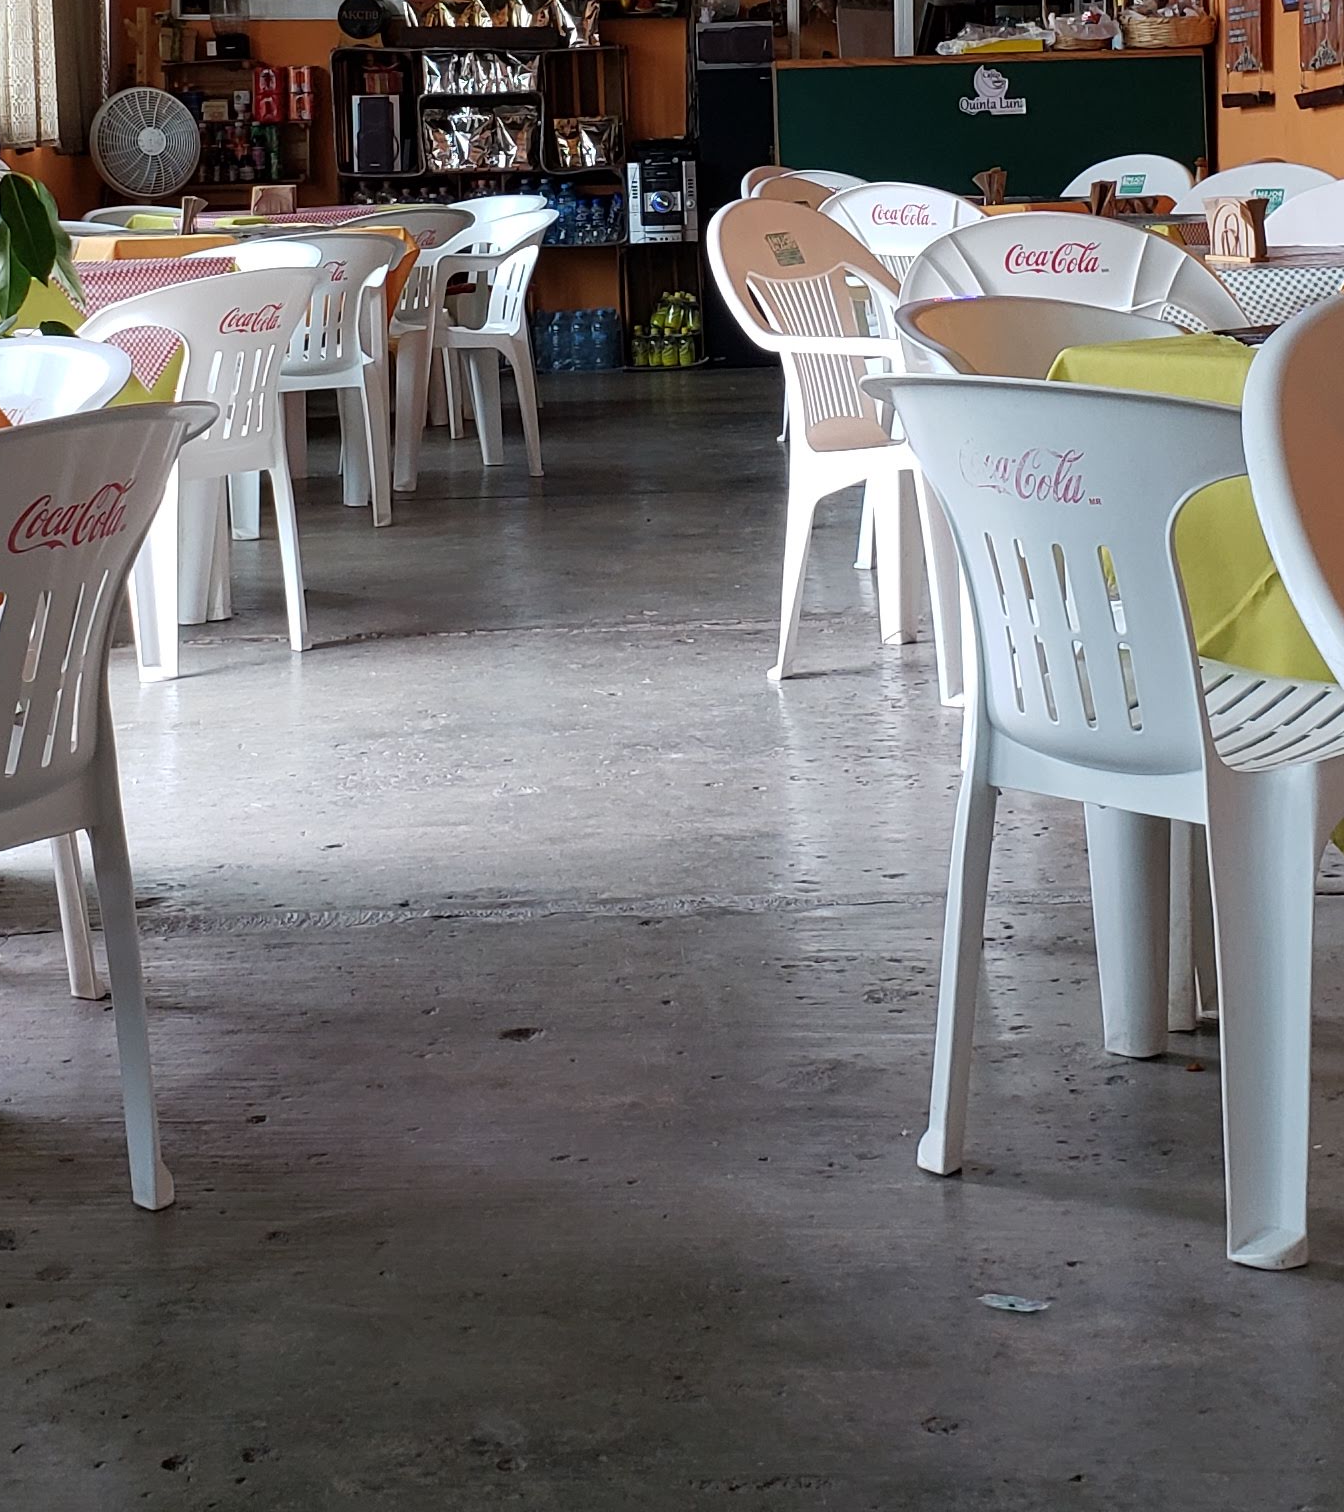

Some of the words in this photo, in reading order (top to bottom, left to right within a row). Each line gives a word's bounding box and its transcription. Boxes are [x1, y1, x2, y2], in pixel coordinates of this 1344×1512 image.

[872, 204, 930, 226] Coca-Cola
[1005, 242, 1102, 274] Coca-Cola
[219, 303, 283, 334] Coca-Cola
[8, 478, 136, 554] Coca-Cola
